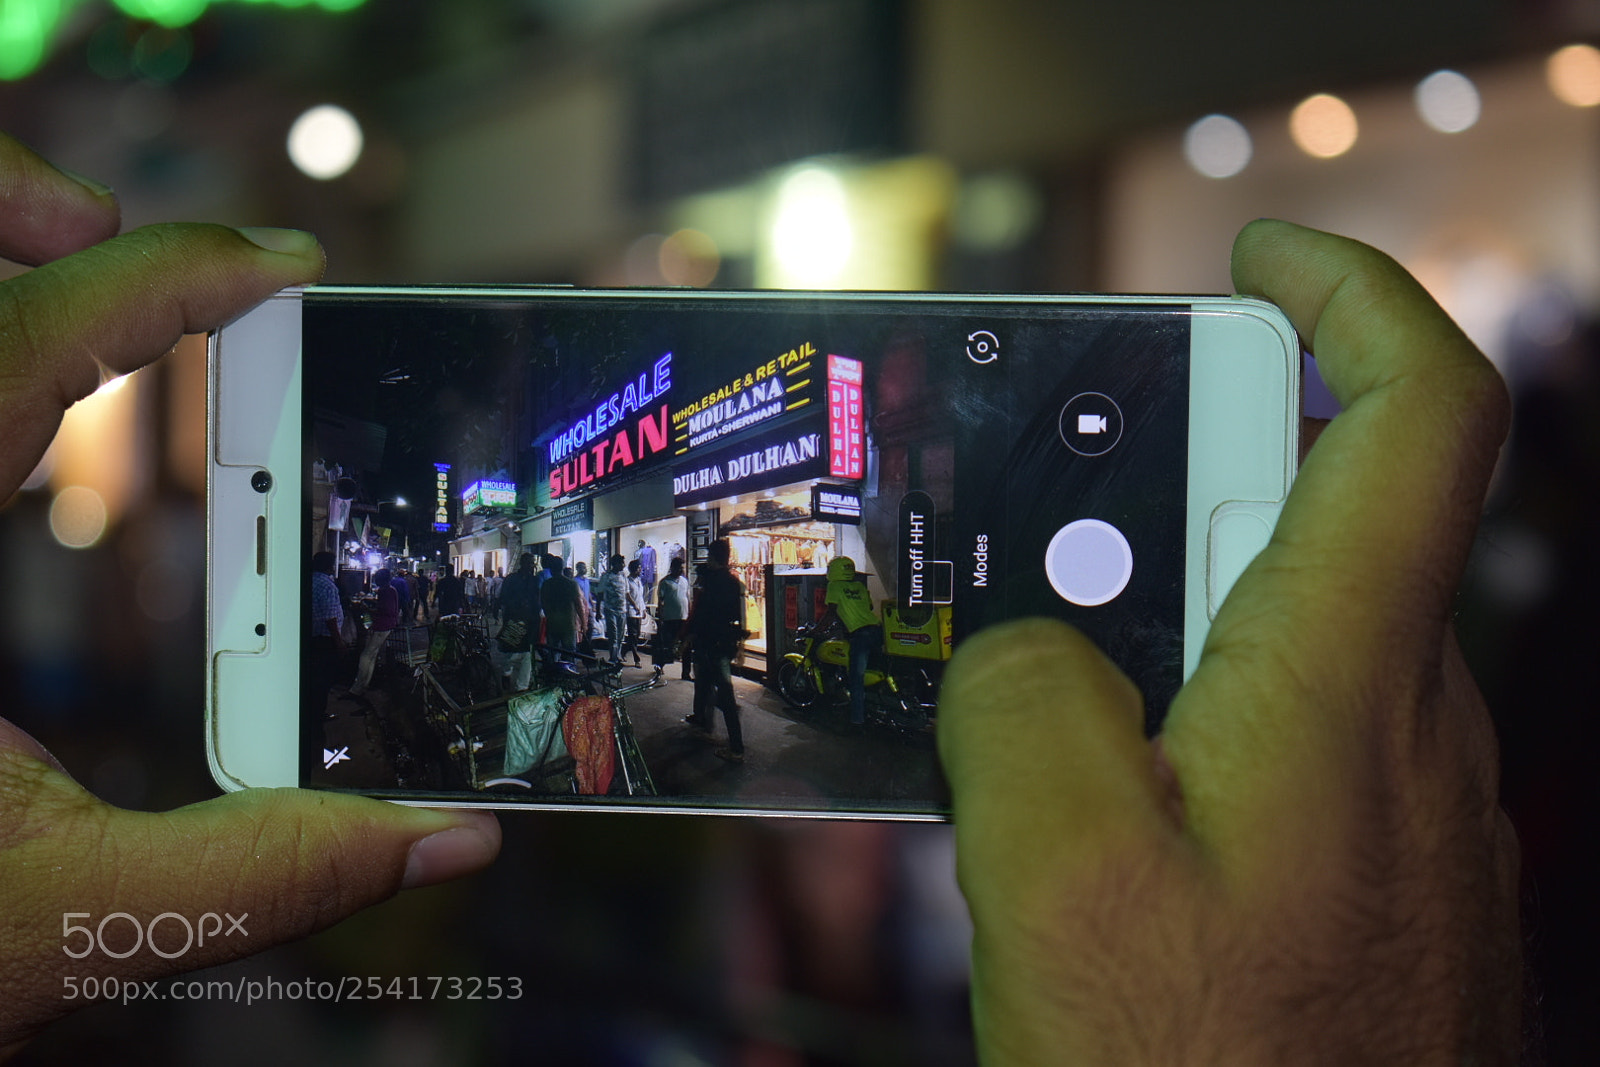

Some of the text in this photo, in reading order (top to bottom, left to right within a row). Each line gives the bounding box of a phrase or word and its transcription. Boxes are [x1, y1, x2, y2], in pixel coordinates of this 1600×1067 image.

[549, 352, 672, 464] WHOLESALE
[672, 378, 742, 424] WHOLESALE
[744, 373, 754, 387] &
[755, 341, 816, 381] RETAIL
[688, 377, 785, 436] MOULANA
[549, 404, 668, 499] SULTAN
[832, 390, 843, 467] DULHA
[849, 388, 860, 474] DULHAN
[481, 480, 516, 491] WHOLESALE
[673, 434, 820, 495] DULHA DULHAN
[437, 472, 448, 523] SULTAN
[553, 502, 585, 520] WHOLESALE
[819, 492, 860, 507] MOULANA
[909, 511, 924, 607] Turn off HHT
[973, 534, 988, 587] Modes
